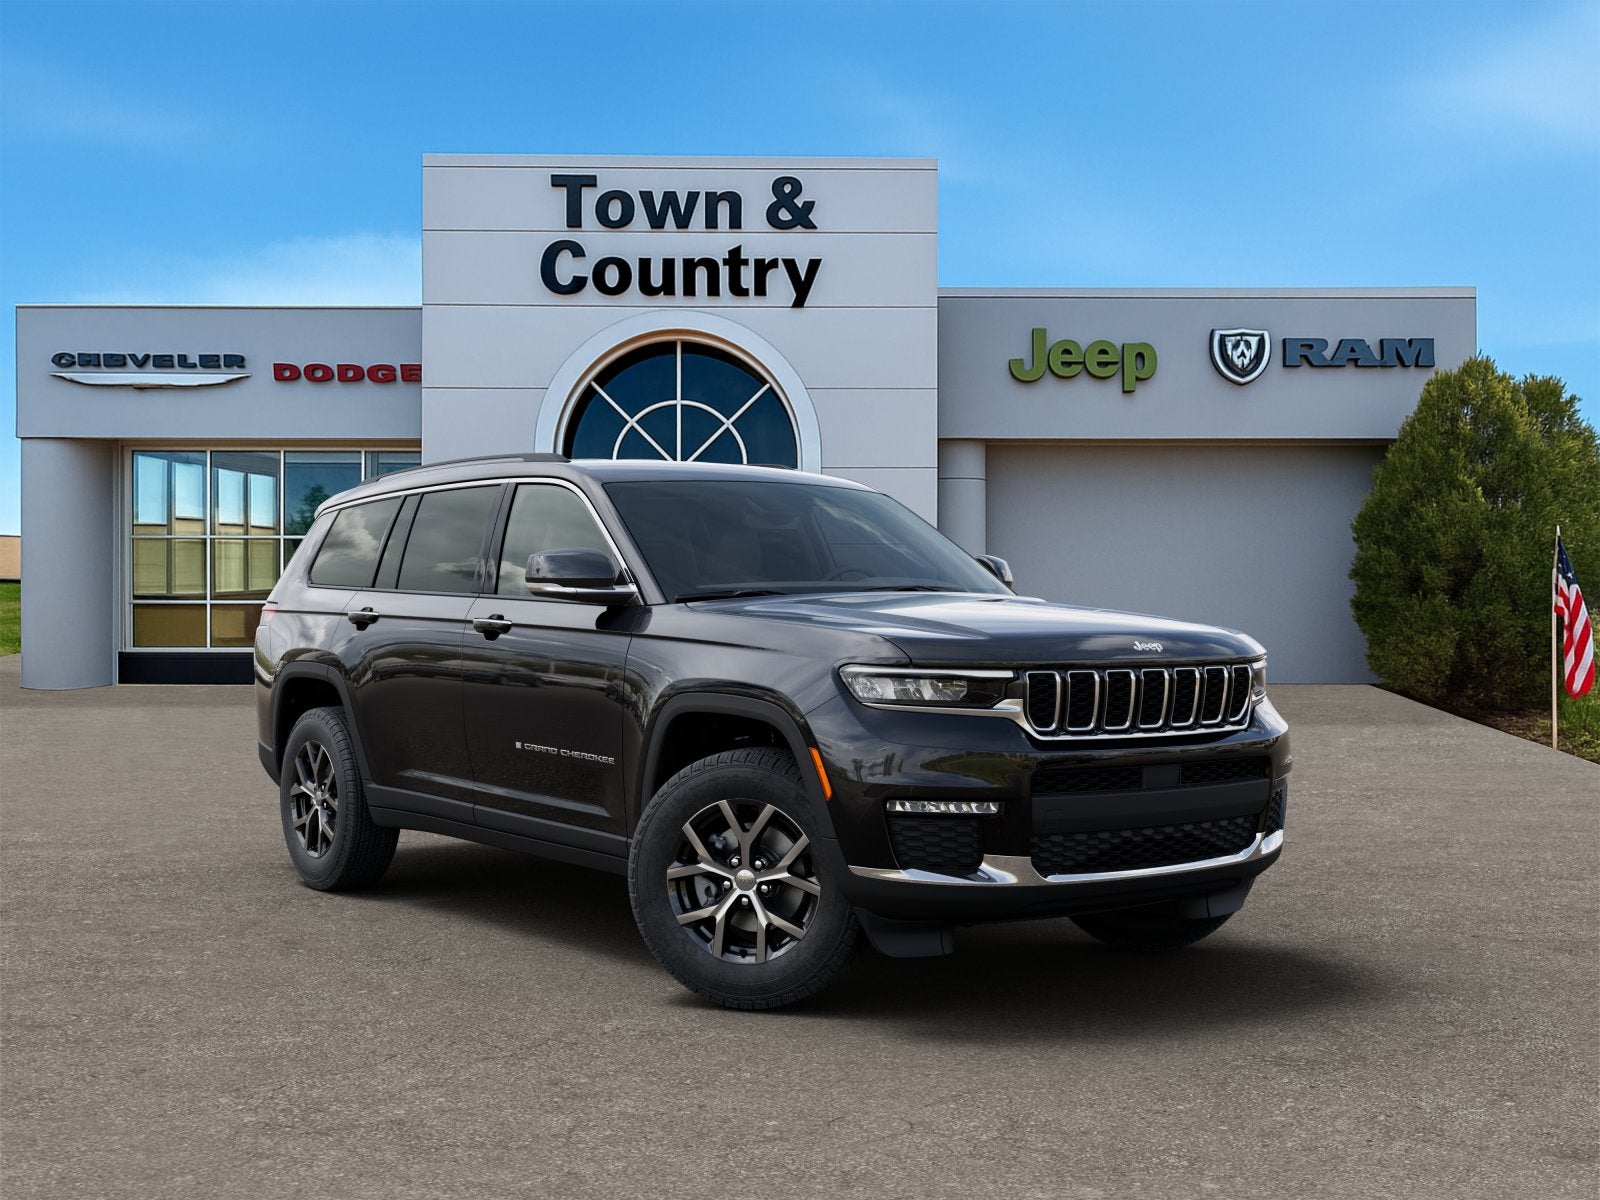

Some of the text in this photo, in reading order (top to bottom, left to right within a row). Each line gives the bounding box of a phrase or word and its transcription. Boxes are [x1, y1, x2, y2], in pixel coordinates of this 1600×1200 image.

[550, 174, 818, 230] Town &
[540, 239, 823, 308] Country
[1009, 327, 1158, 393] Jeep
[1282, 337, 1436, 368] RAM
[273, 362, 422, 383] DODGE
[1133, 640, 1163, 652] Jeep
[560, 749, 616, 765] CHEROKEE
